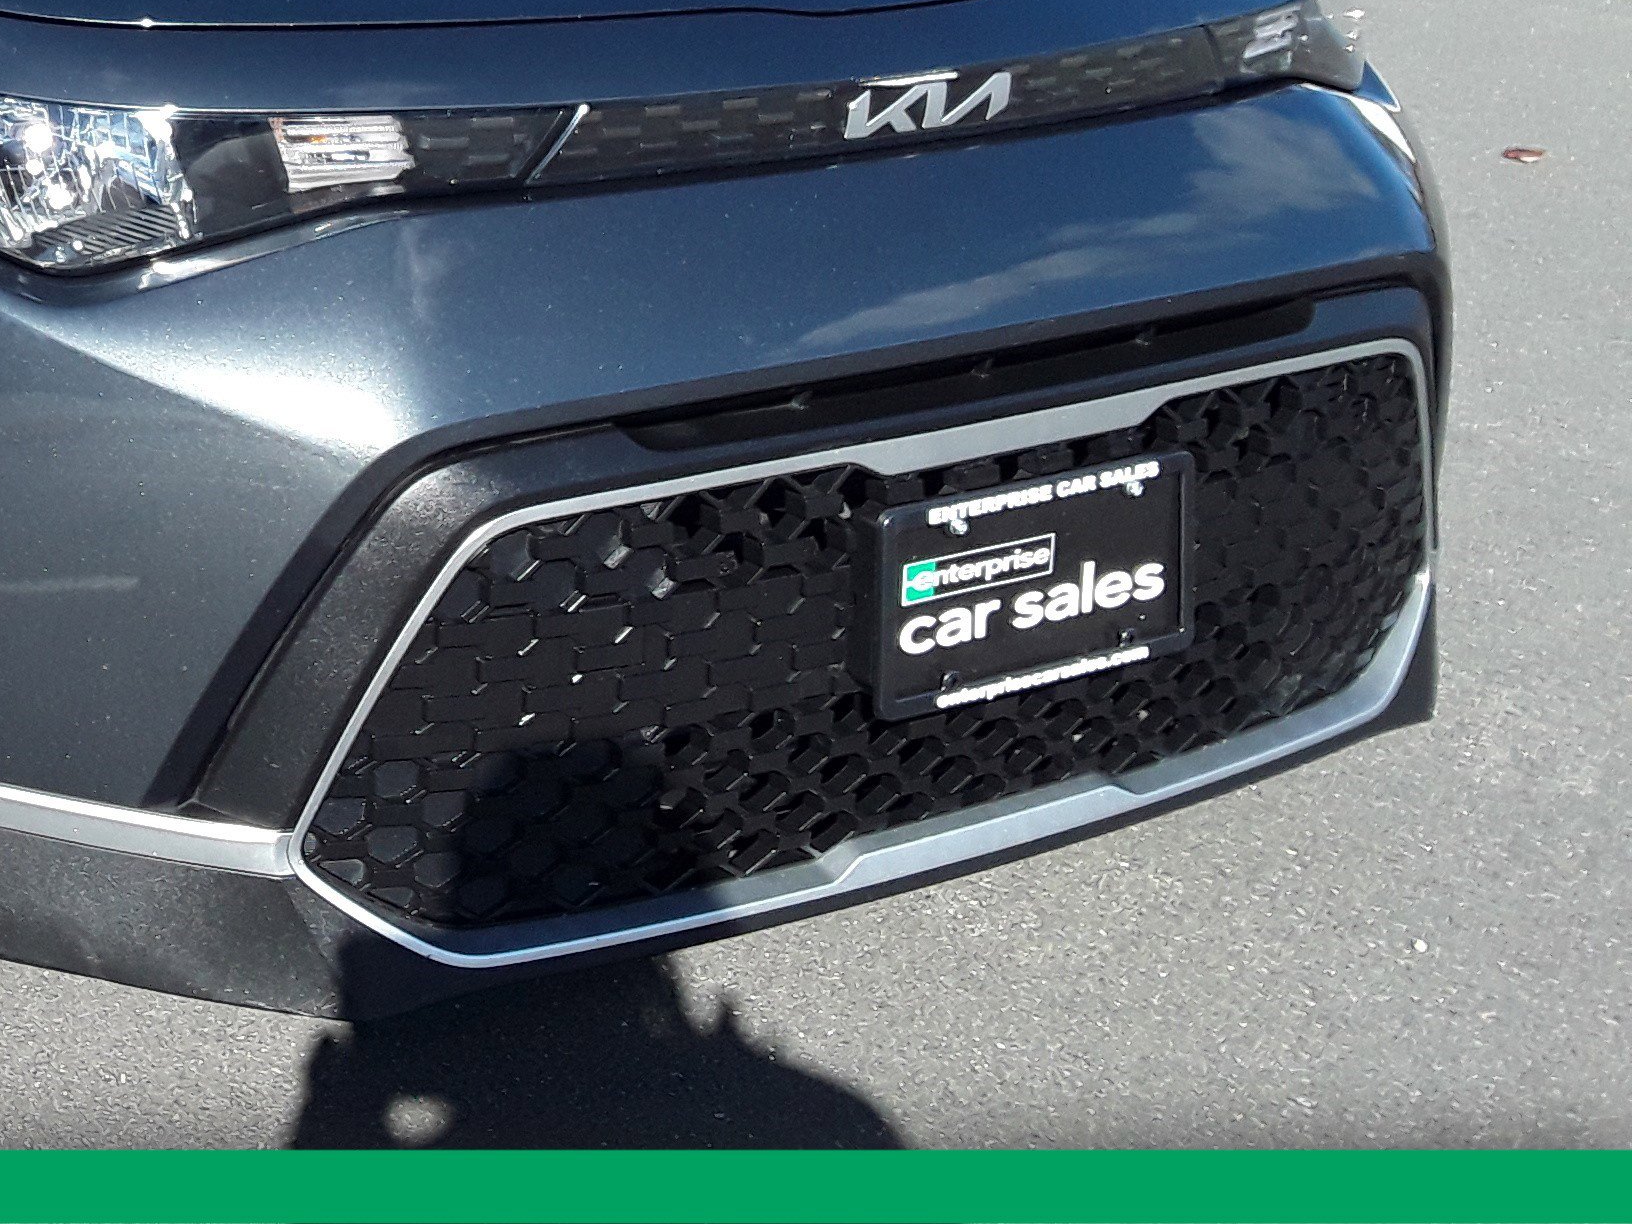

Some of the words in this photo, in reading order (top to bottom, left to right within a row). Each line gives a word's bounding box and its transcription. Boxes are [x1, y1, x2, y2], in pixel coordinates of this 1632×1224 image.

[1056, 472, 1097, 499] CAR
[1099, 460, 1160, 489] SALES
[911, 547, 1051, 592] enterprise
[898, 596, 1001, 656] car
[1010, 560, 1166, 630] sales
